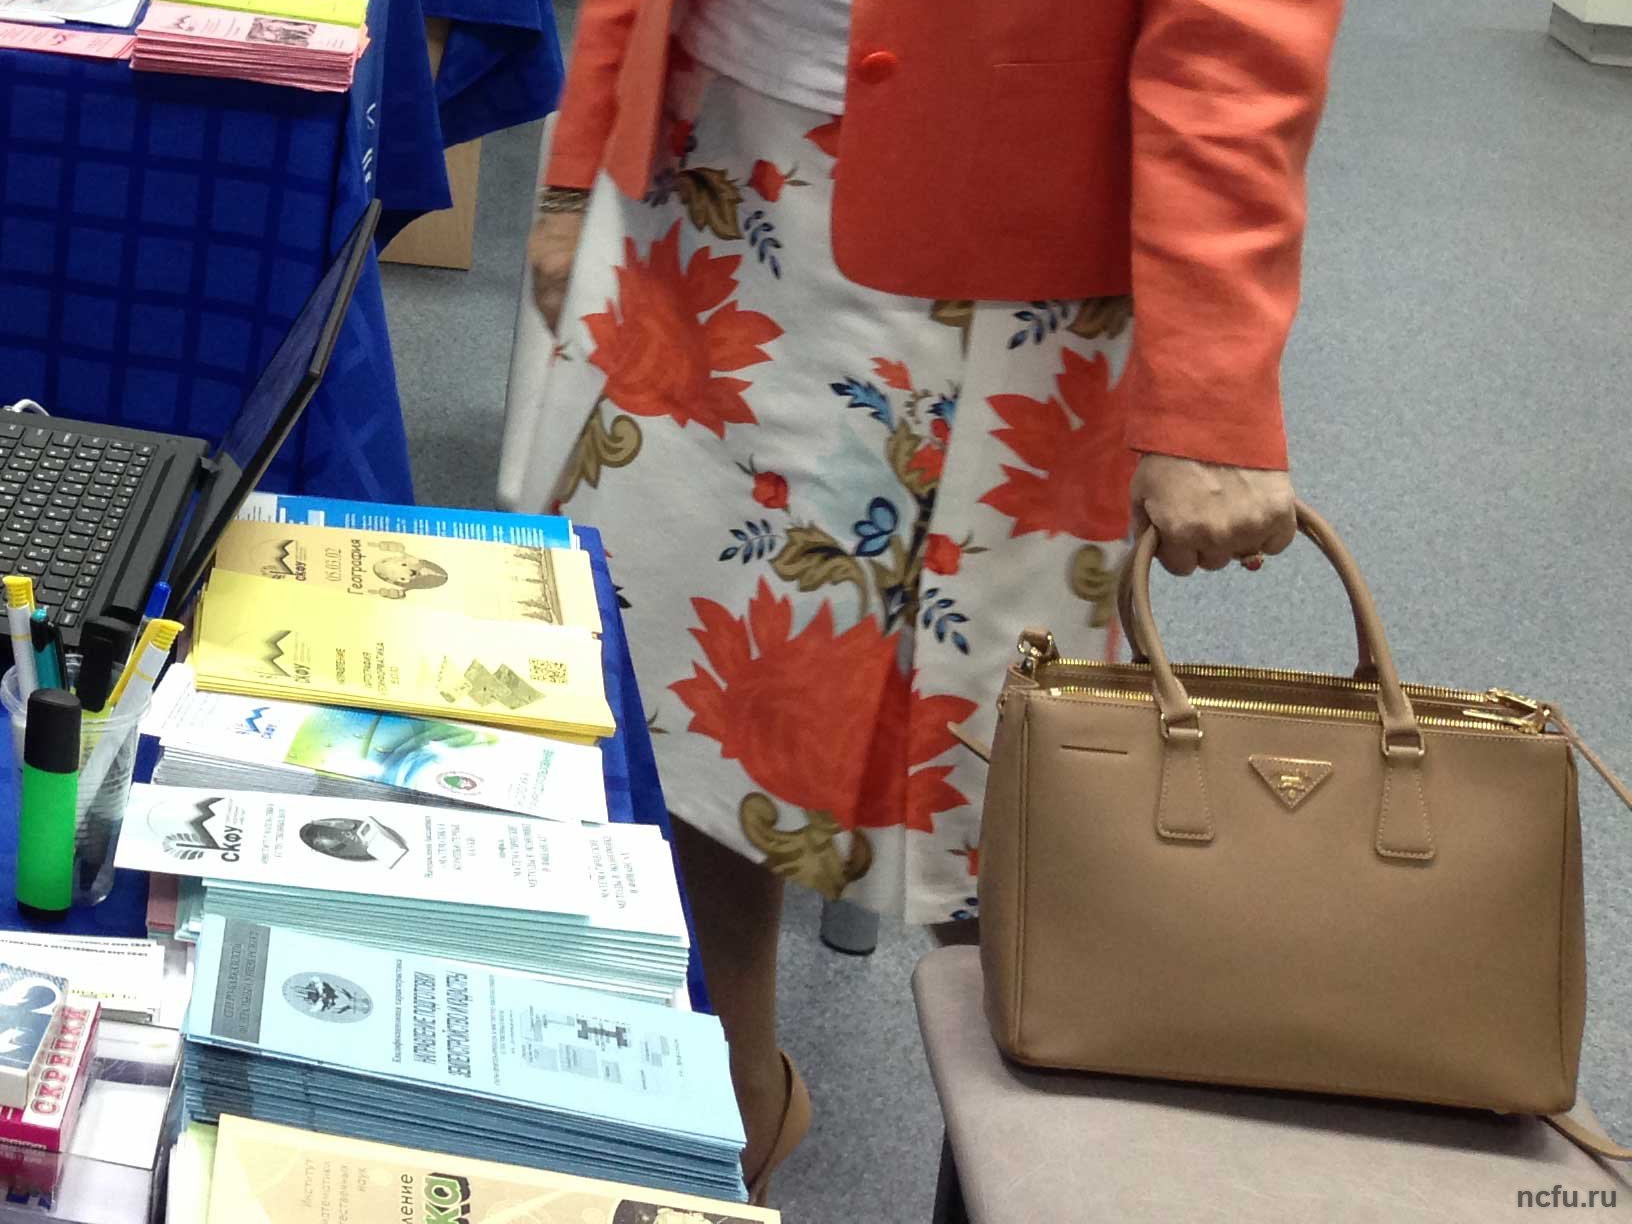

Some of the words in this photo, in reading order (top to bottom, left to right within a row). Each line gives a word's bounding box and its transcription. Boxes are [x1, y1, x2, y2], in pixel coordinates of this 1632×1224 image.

[347, 538, 366, 596] География
[221, 825, 243, 863] СКФУ
[30, 1006, 91, 1116] СКРЕПКИ
[300, 1160, 317, 1208] Институт
[357, 1168, 370, 1193] наук
